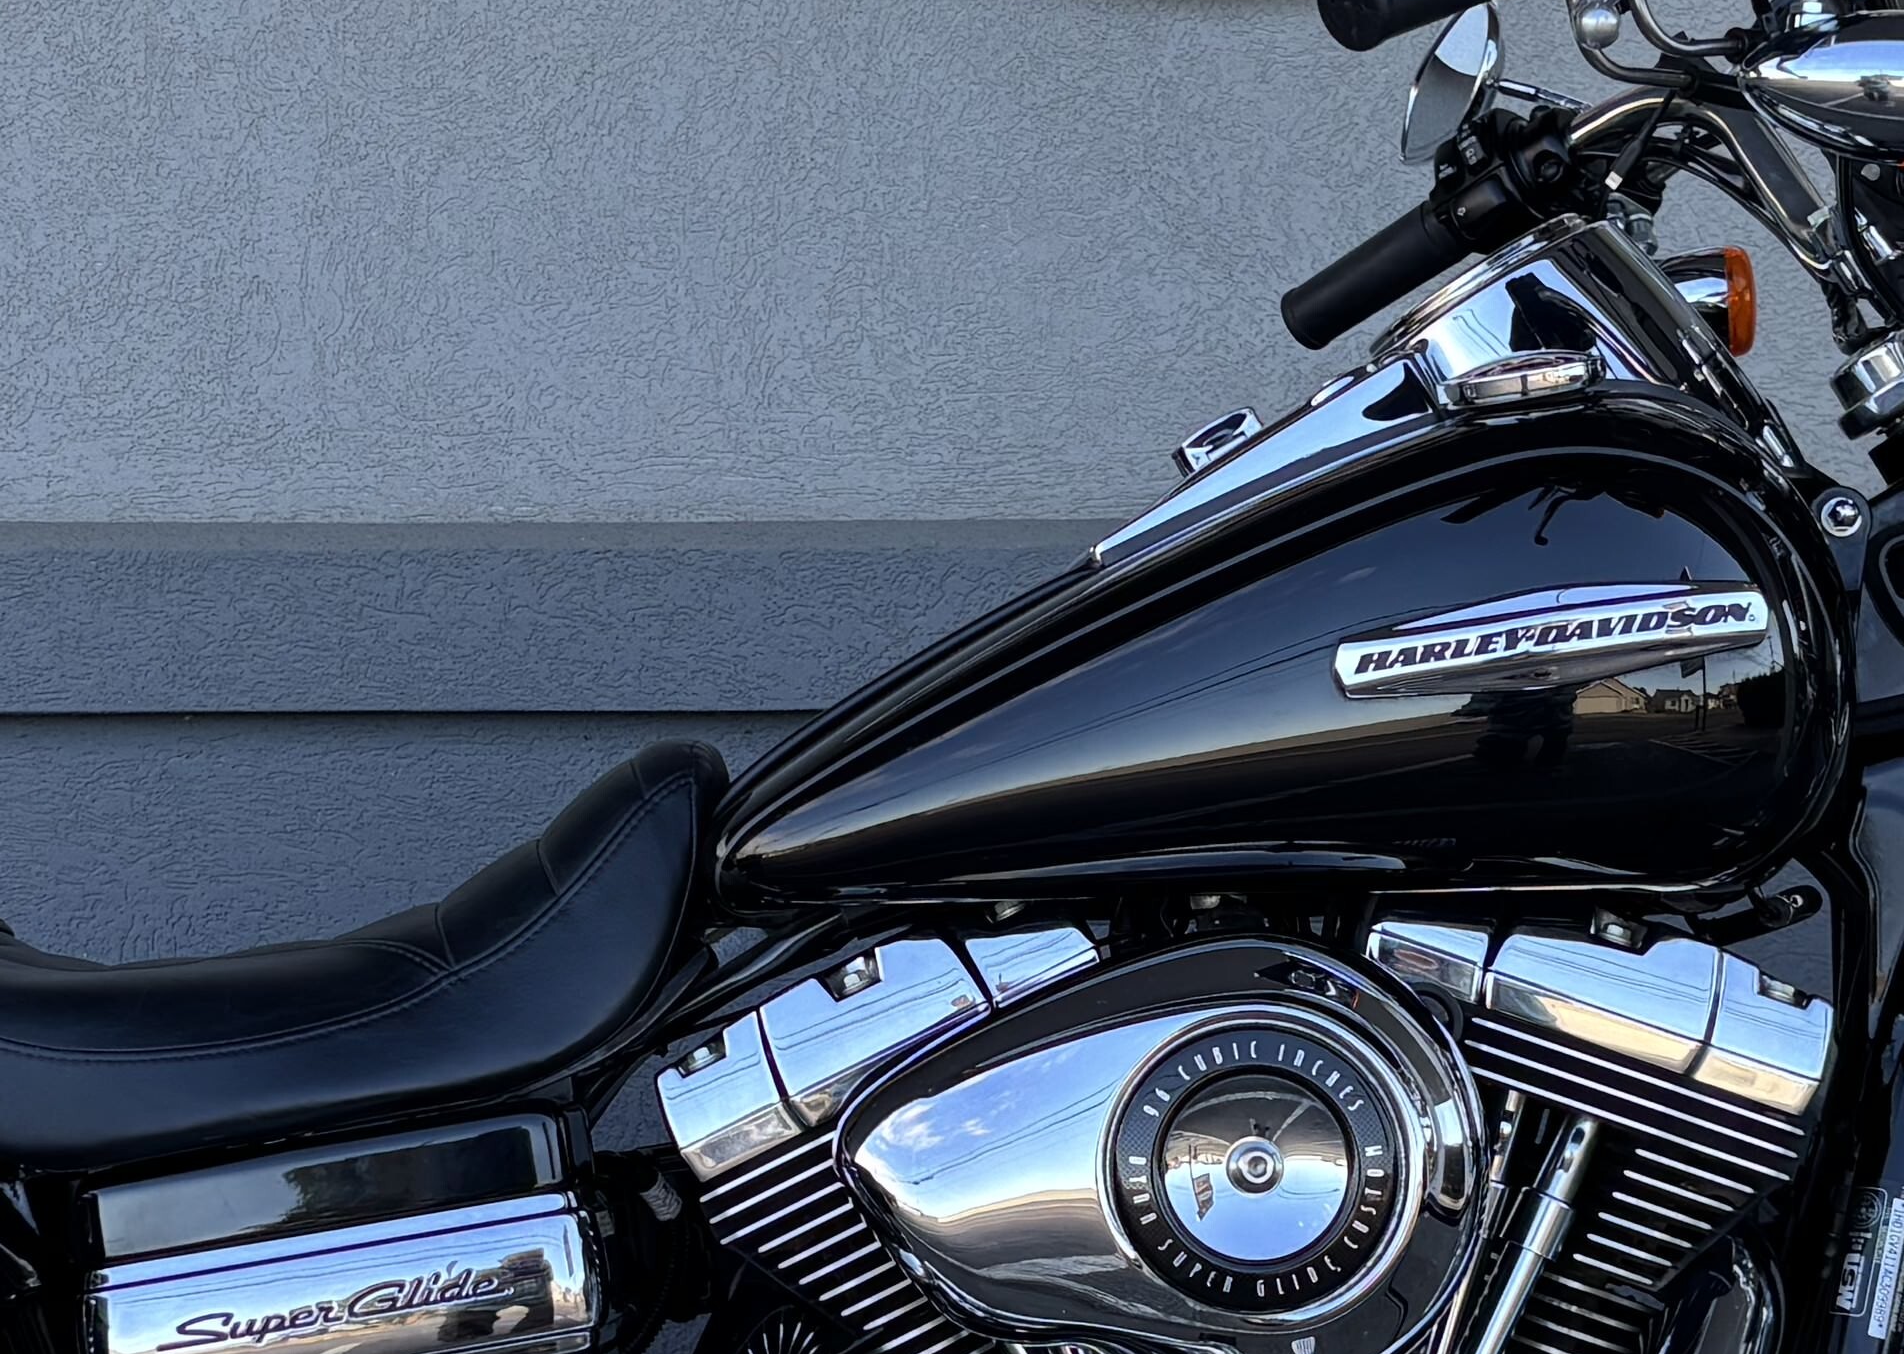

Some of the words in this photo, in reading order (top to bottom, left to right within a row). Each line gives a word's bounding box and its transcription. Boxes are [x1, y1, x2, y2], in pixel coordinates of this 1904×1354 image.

[1353, 602, 1752, 675] HARLEY-DAVIDSON
[1142, 1088, 1171, 1117] 96
[1178, 1040, 1258, 1082] CUBIC
[1278, 1043, 1365, 1112] INCHES
[1157, 1238, 1233, 1293] SUPER
[1343, 1145, 1385, 1249] CUSTOM
